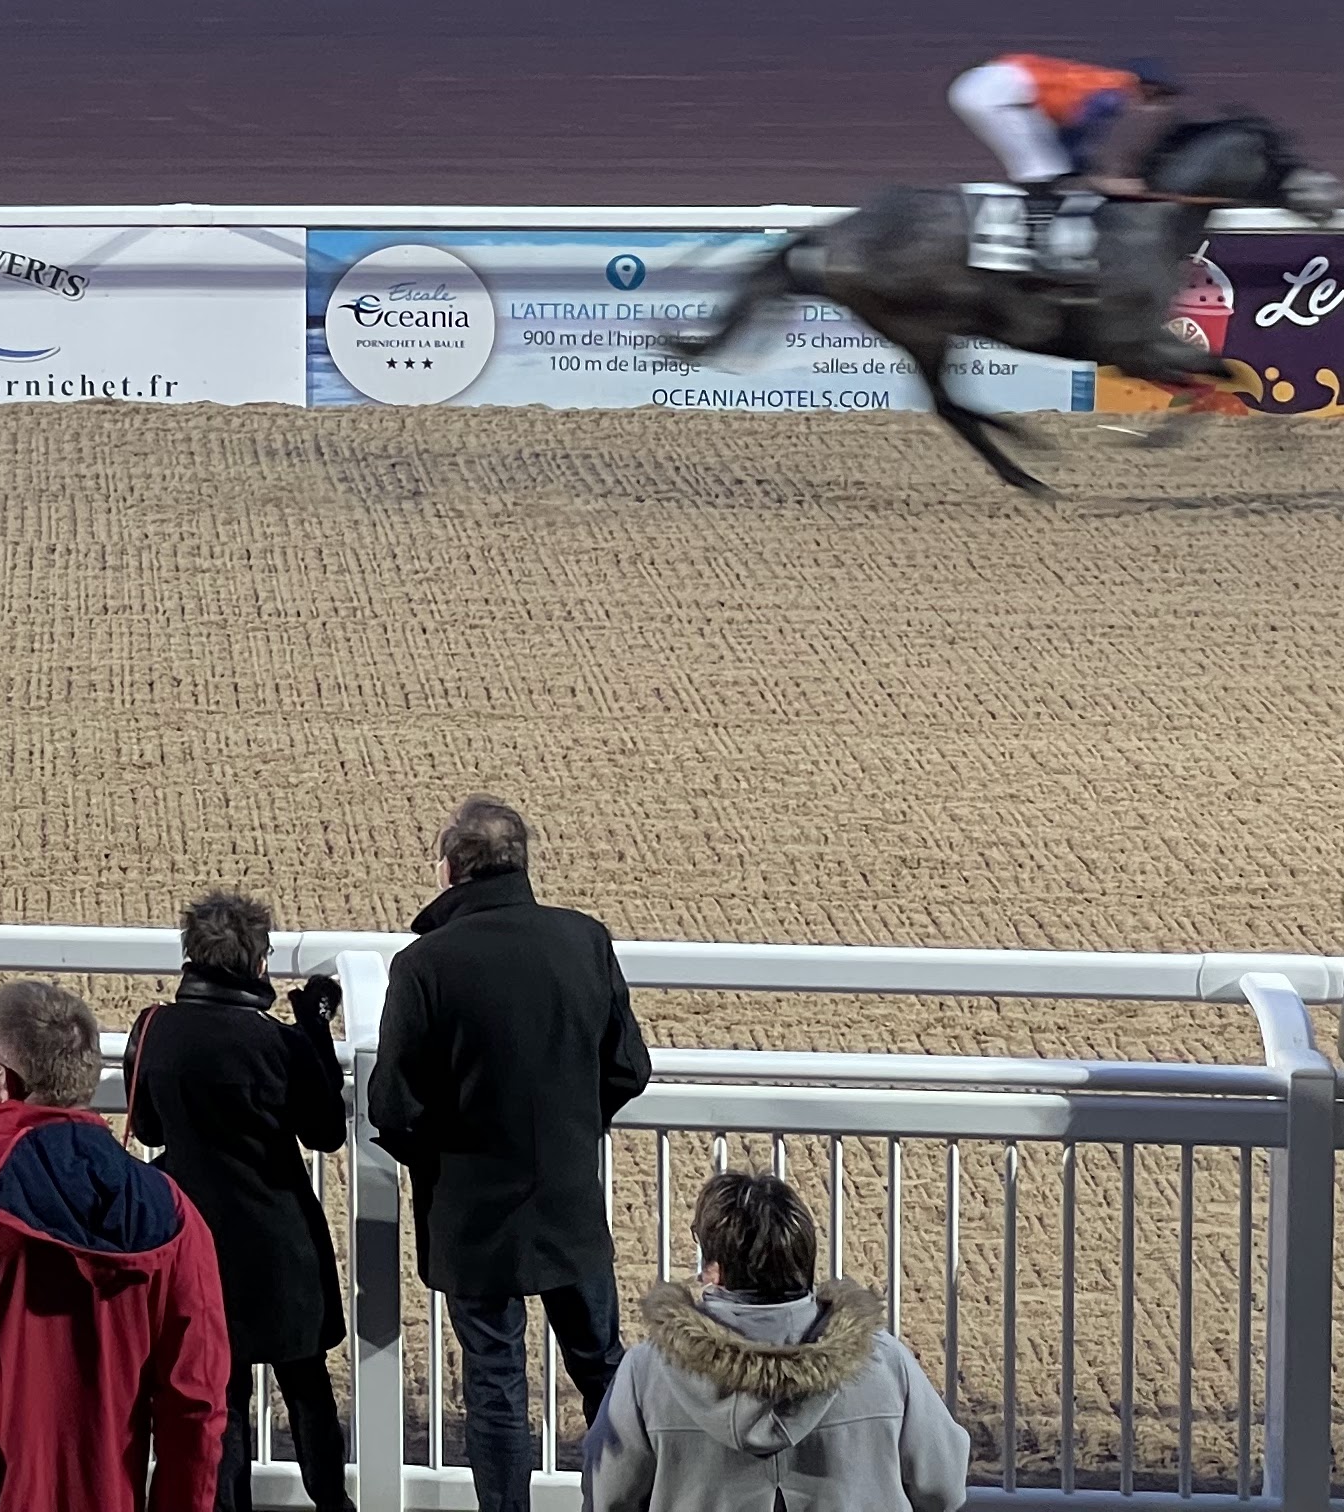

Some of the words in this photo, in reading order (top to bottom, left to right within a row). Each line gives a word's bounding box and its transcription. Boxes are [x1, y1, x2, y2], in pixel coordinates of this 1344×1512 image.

[389, 282, 457, 301] Escale
[339, 294, 470, 328] Oceania
[511, 302, 610, 320] L'ATTRAIT
[616, 303, 644, 320] DE
[803, 305, 842, 322] DES
[356, 340, 415, 348] PORNICHET
[418, 340, 431, 348] LA
[434, 340, 465, 348] BAULE
[523, 330, 555, 346] 900
[560, 333, 576, 346] m
[581, 330, 603, 346] de
[786, 332, 806, 348] 95
[811, 332, 895, 348] chambre
[550, 356, 581, 371] 100
[585, 359, 602, 371] m
[606, 356, 628, 372] de
[633, 356, 647, 372] la
[652, 356, 701, 376] plage
[813, 358, 857, 374] salles
[862, 358, 885, 374] de
[971, 359, 985, 375] &
[989, 359, 1019, 375] bar
[652, 388, 890, 408] OCEANIAHOTELS.COM
